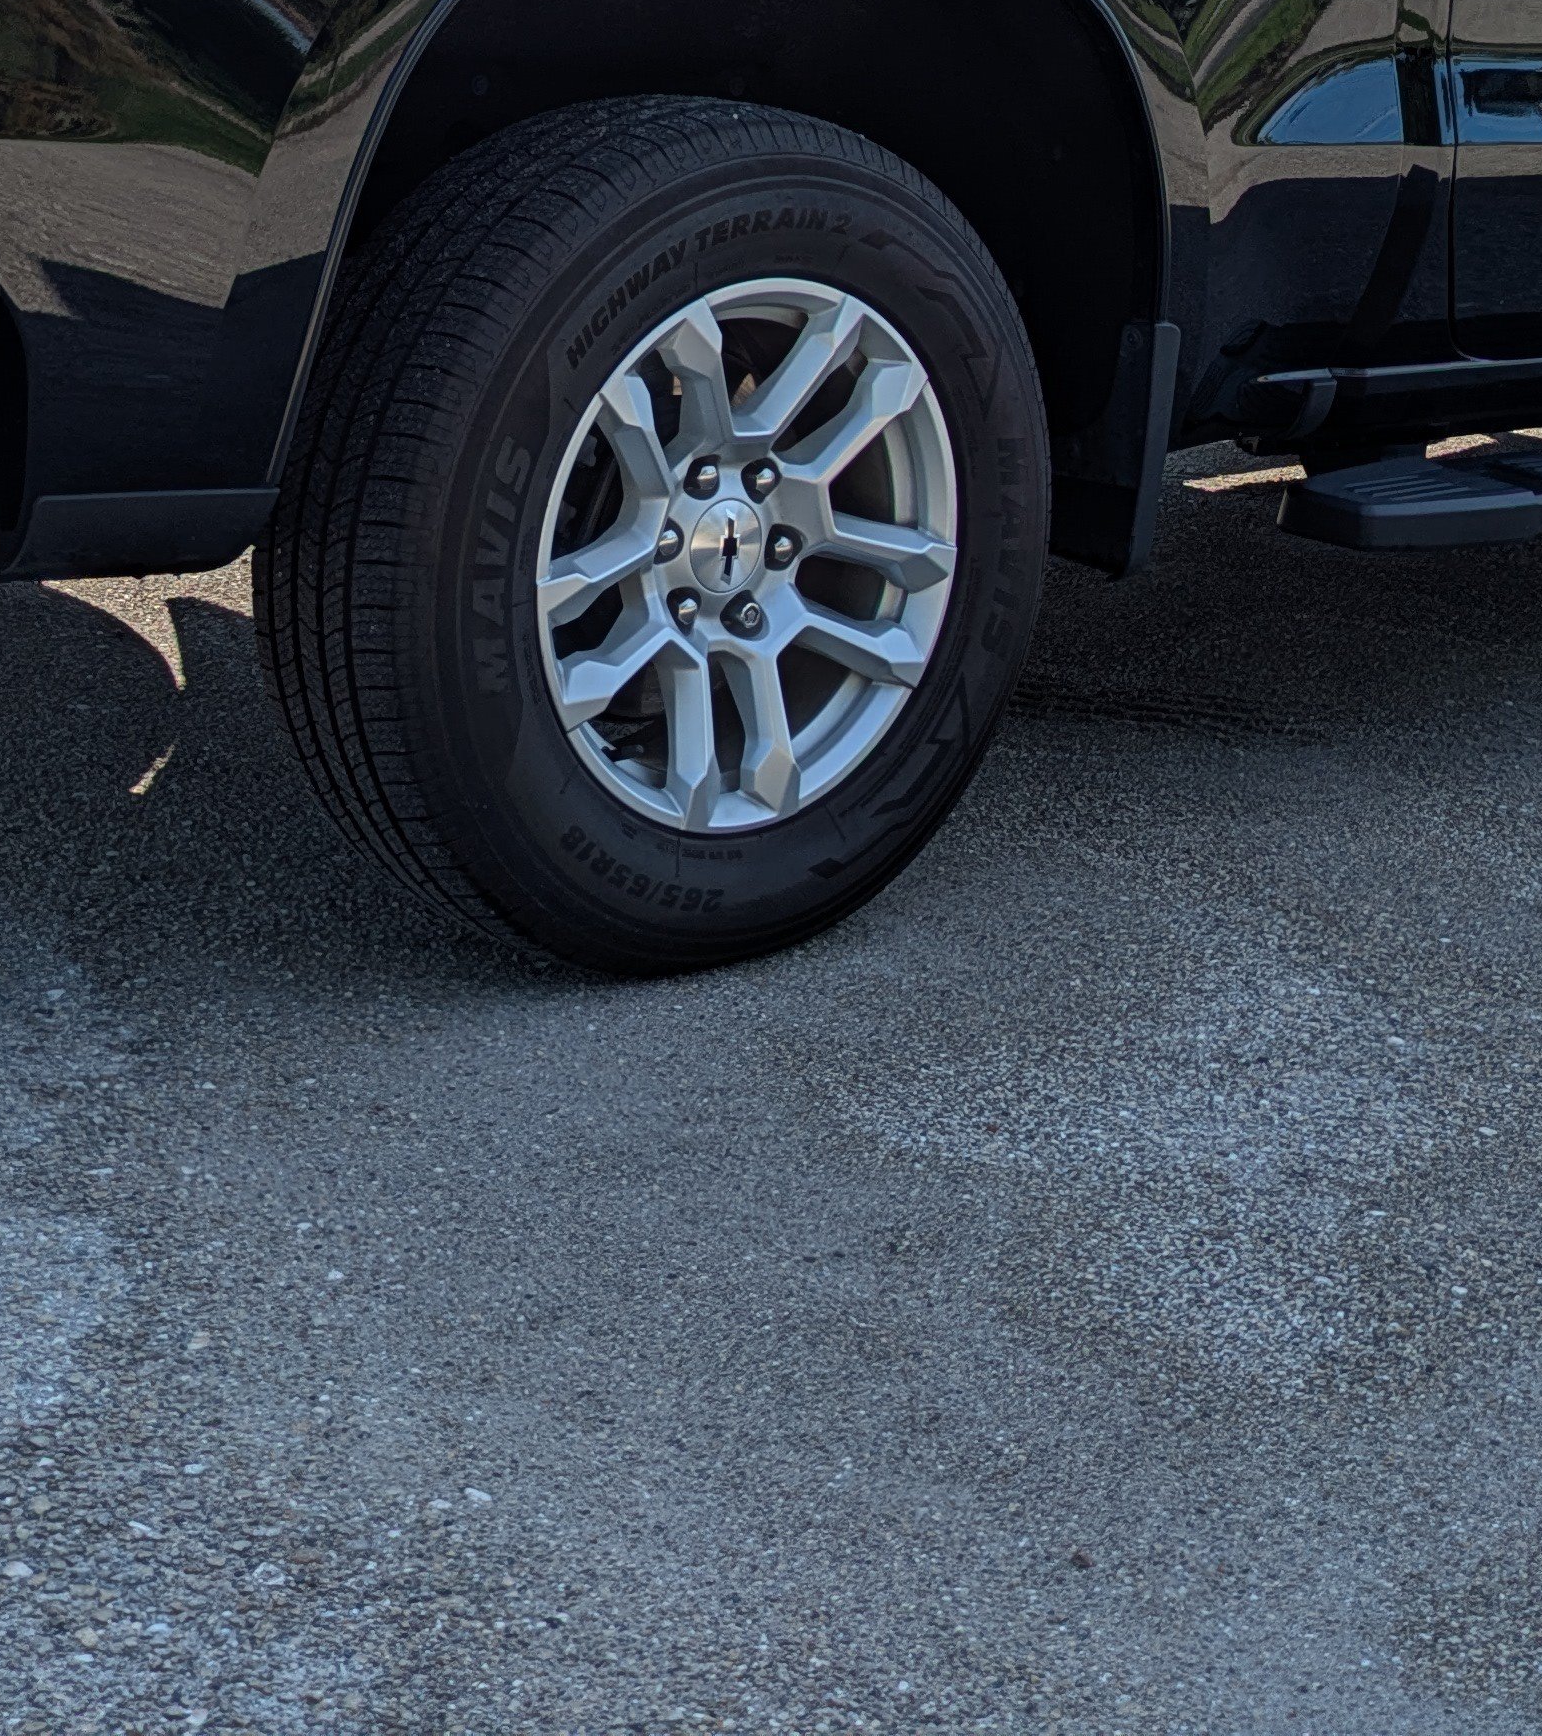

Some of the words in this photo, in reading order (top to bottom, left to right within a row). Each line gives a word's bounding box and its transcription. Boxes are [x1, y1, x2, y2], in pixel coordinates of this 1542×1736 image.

[564, 238, 688, 370] HIGHWAY
[694, 208, 829, 253] TERRAIN
[830, 214, 853, 235] 2
[472, 435, 532, 694] MAVIS
[561, 825, 725, 914] 265/65R18
